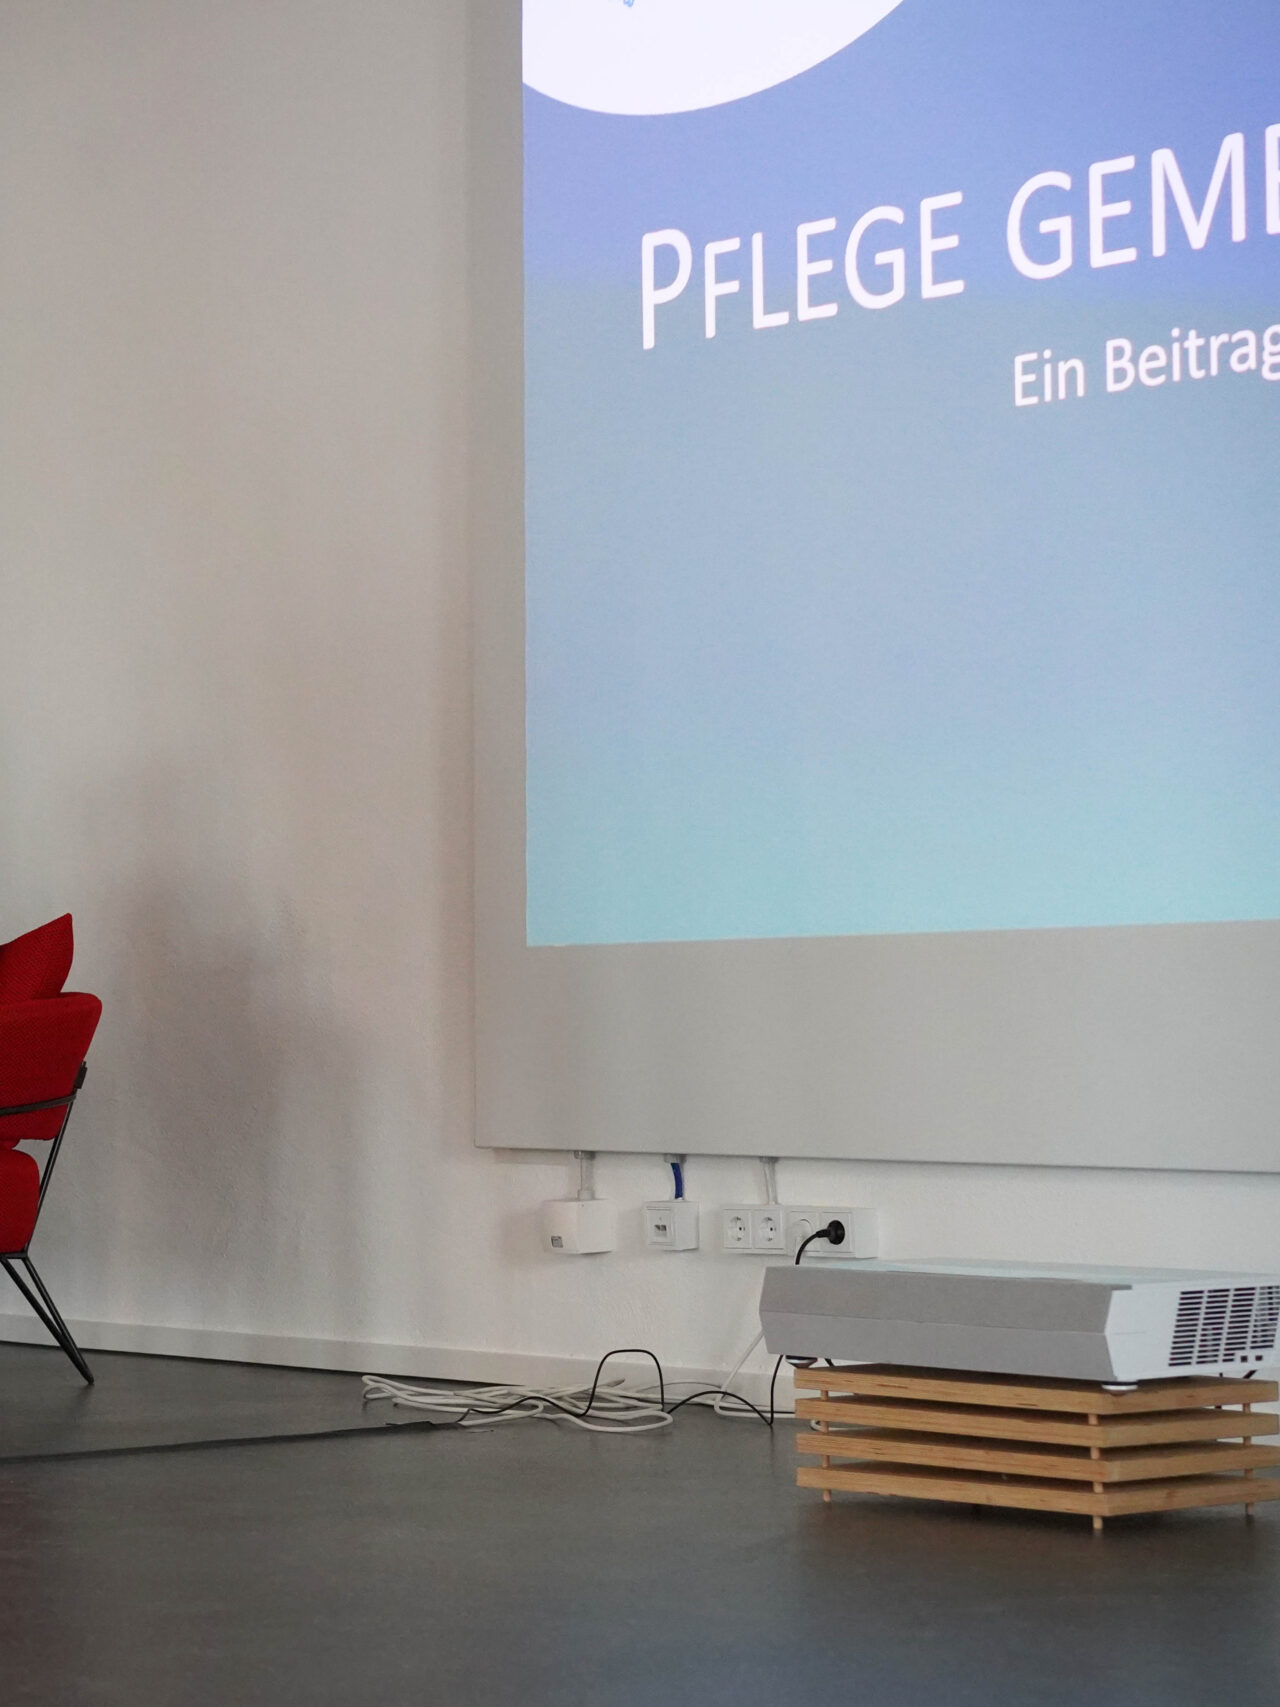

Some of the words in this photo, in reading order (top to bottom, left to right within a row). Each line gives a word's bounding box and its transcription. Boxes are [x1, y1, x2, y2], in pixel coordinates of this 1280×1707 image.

[641, 190, 966, 351] PFLEGE
[1014, 350, 1086, 408] Ein
[1105, 323, 1280, 394] Beitrag
